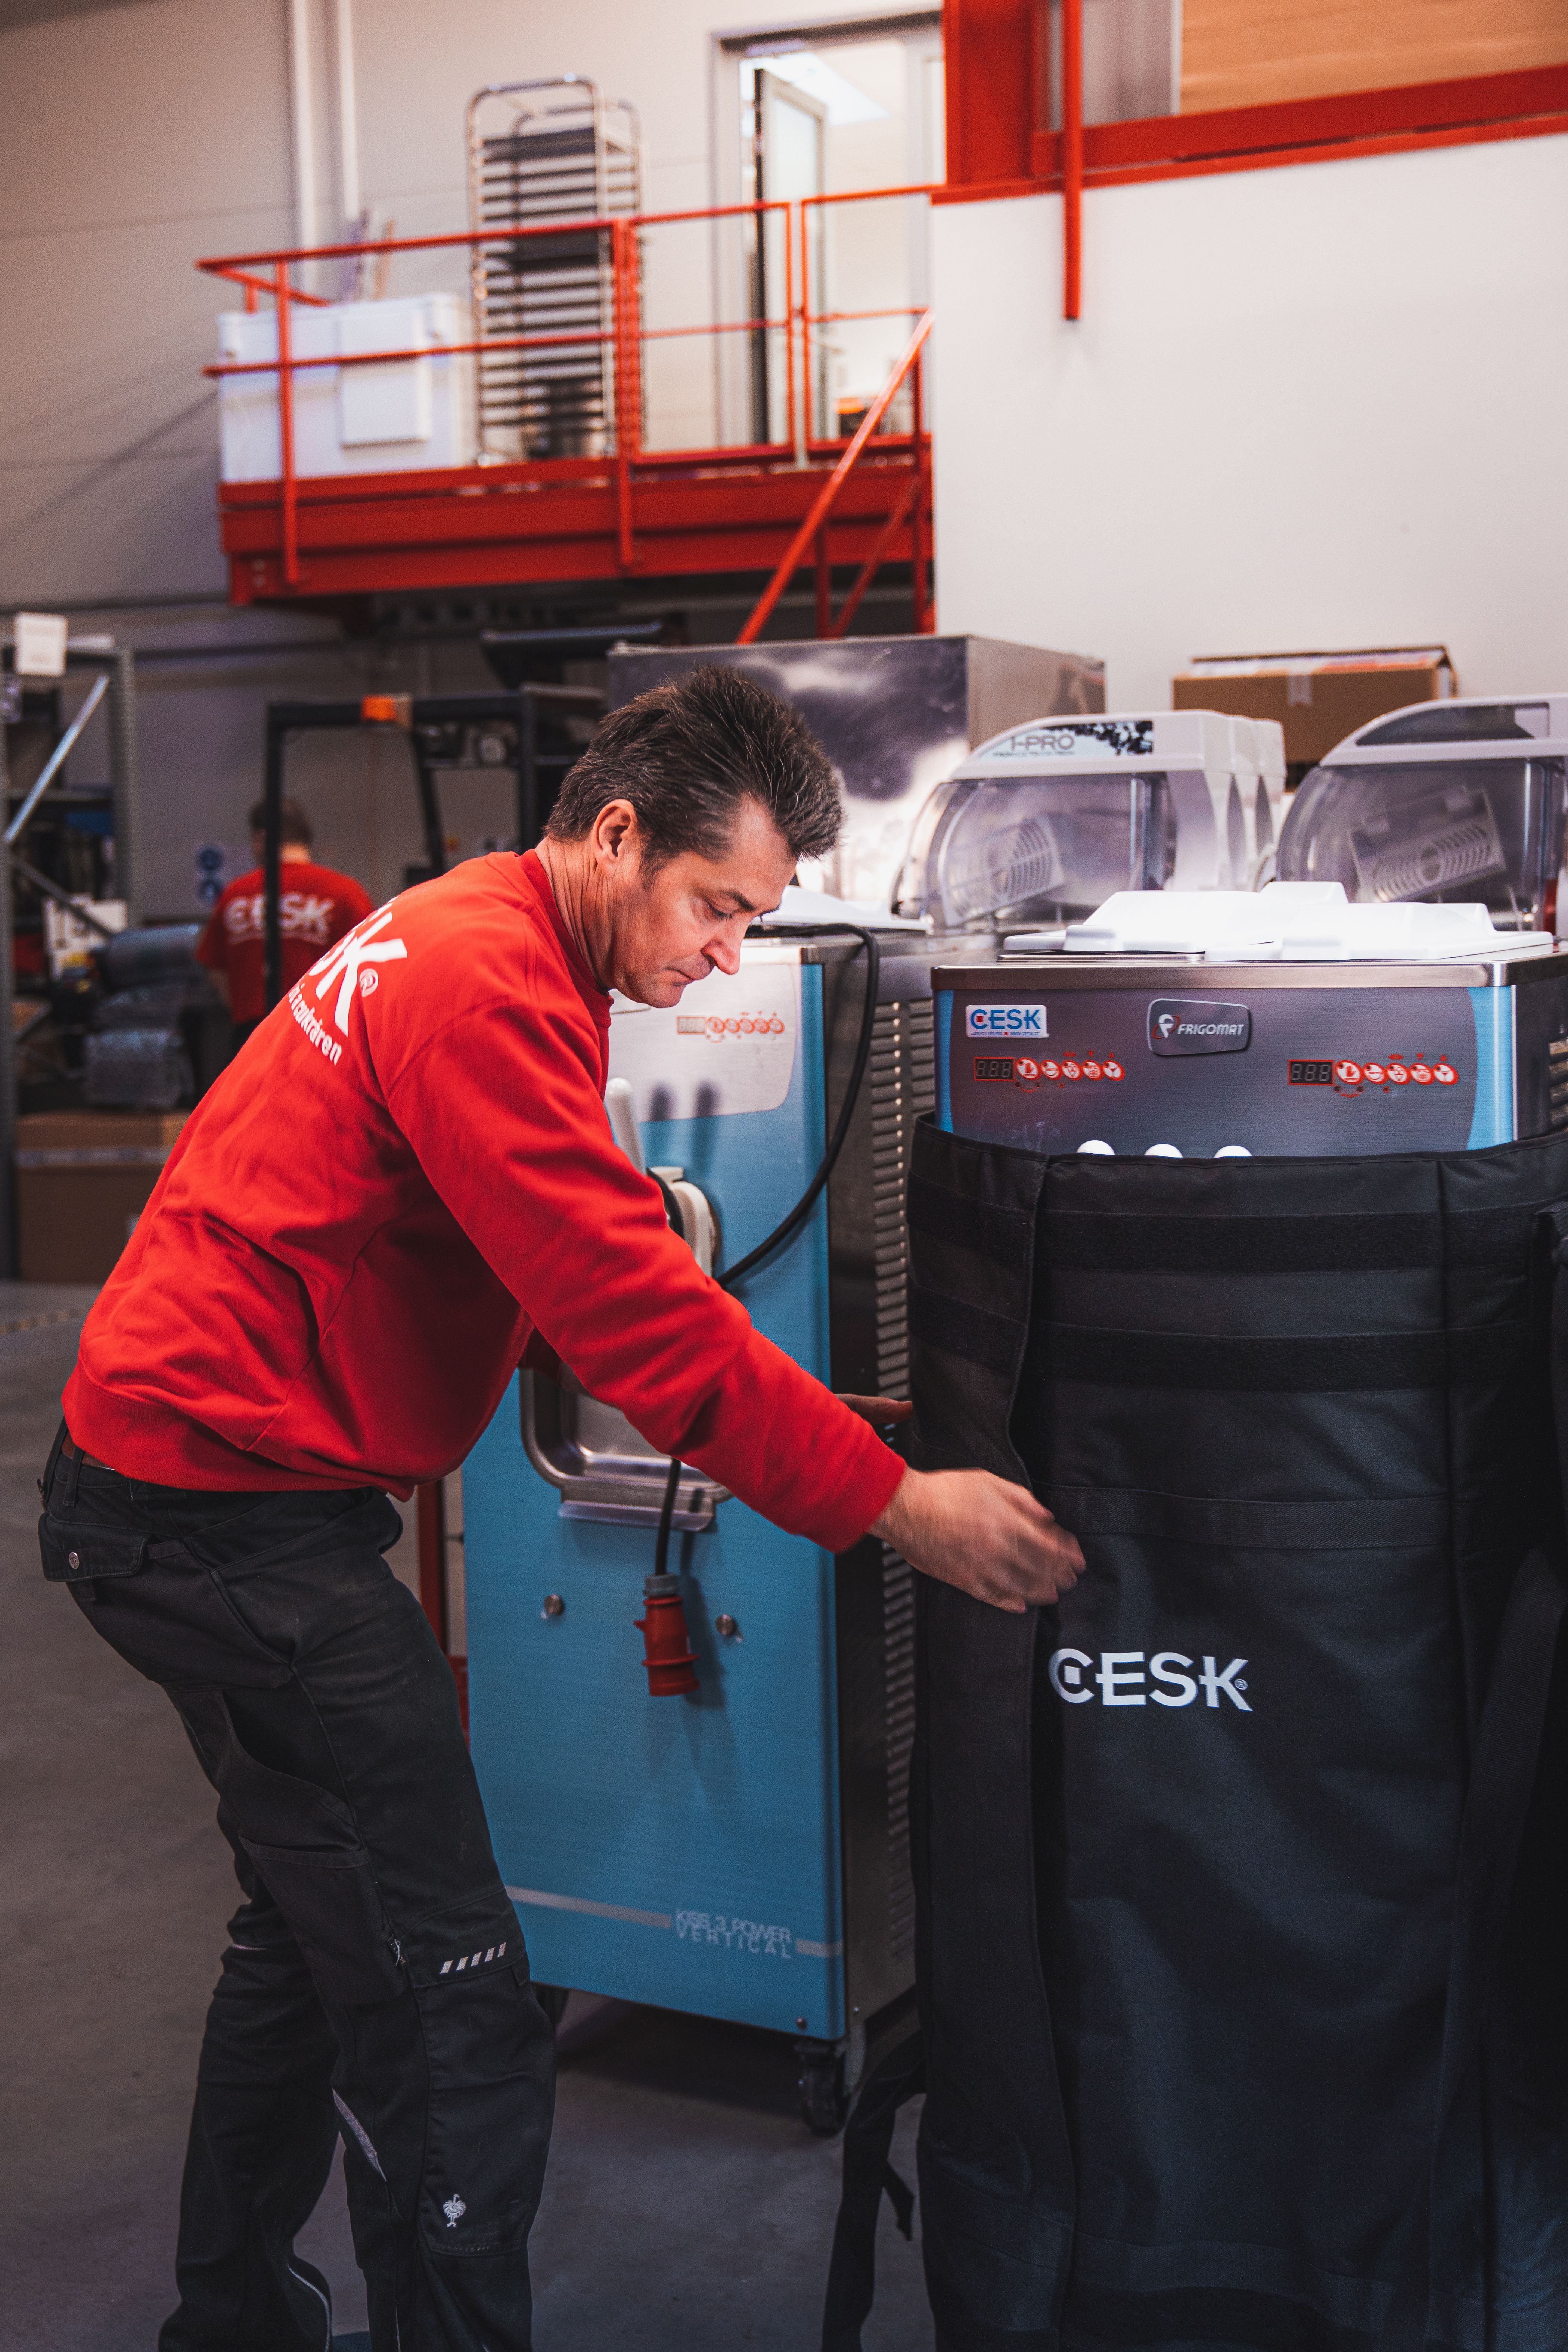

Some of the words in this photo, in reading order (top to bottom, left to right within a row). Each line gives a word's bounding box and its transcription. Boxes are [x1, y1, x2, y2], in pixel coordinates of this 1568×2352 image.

[971, 1009, 1041, 1030] CESK
[1177, 1024, 1245, 1035] FRIGOMAT
[1048, 1648, 1253, 1711] CESK
[676, 1923, 791, 1959] VERTICAL
